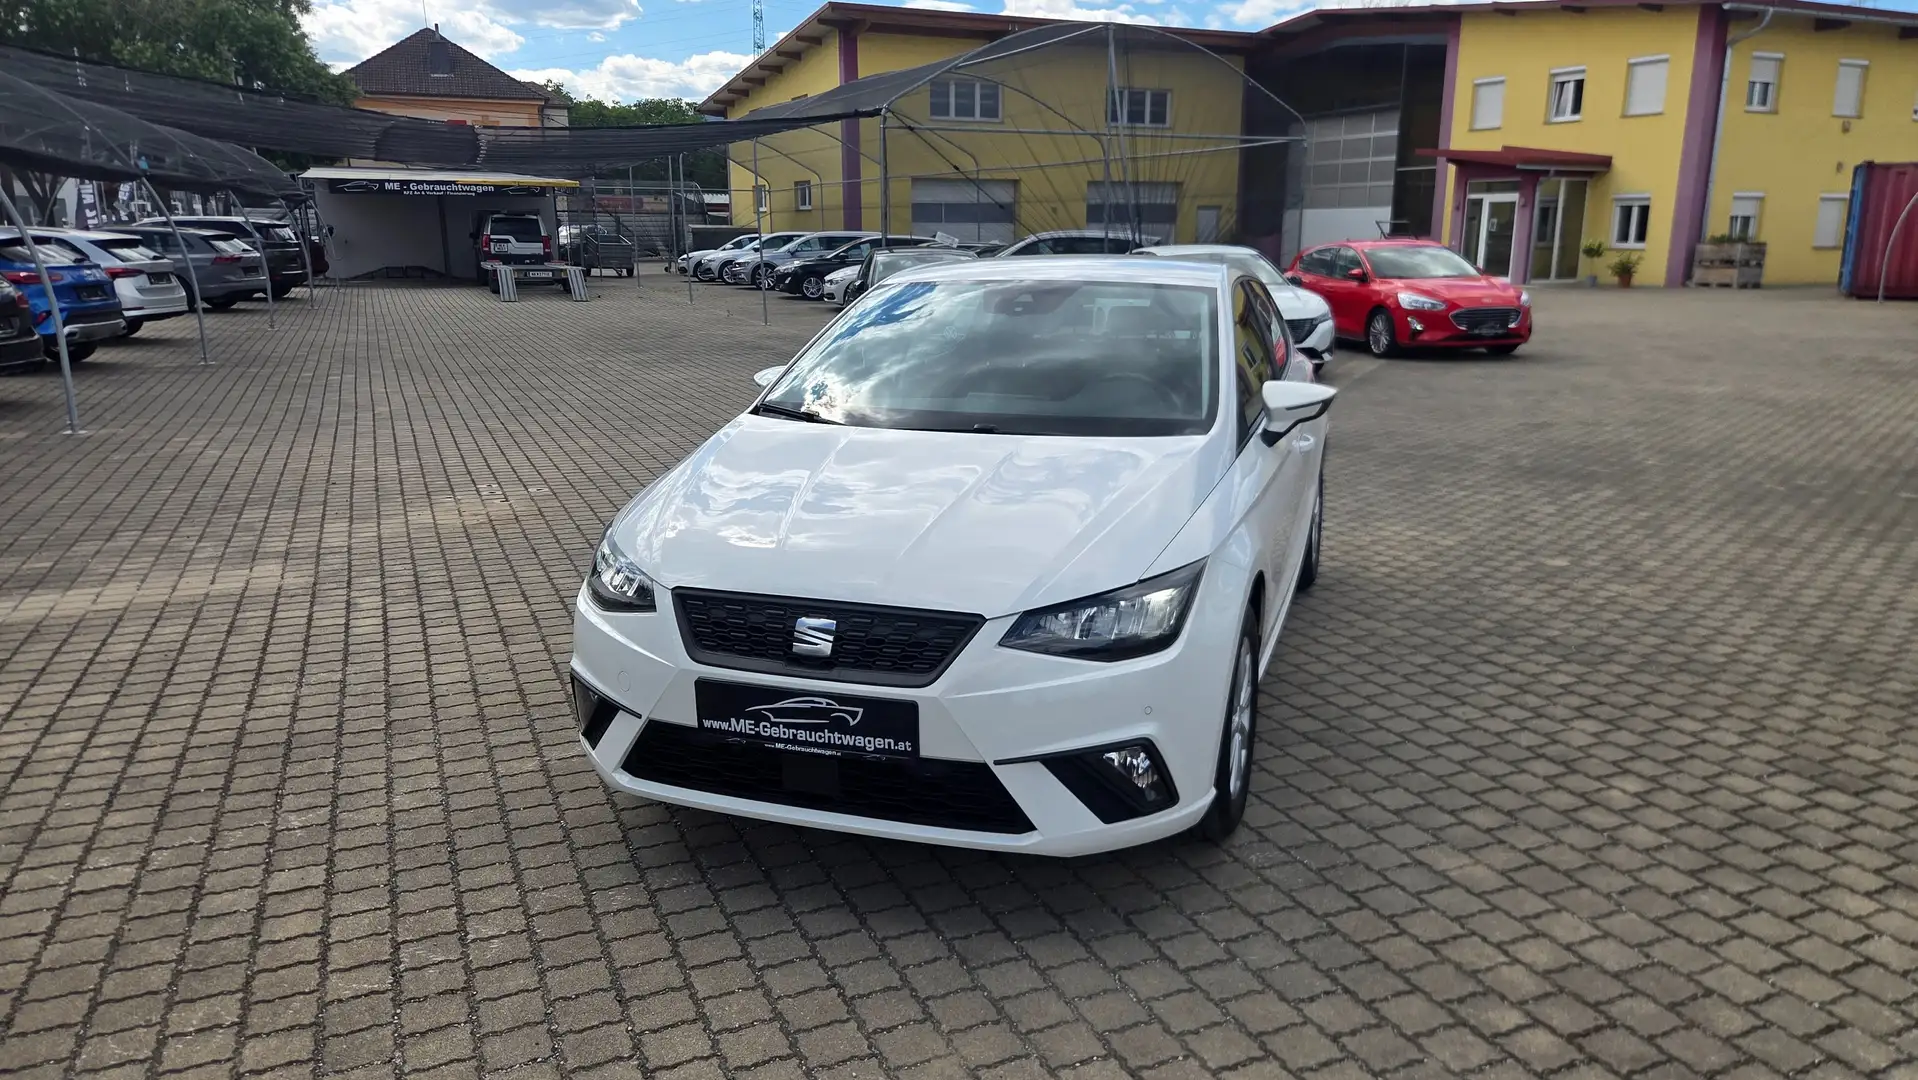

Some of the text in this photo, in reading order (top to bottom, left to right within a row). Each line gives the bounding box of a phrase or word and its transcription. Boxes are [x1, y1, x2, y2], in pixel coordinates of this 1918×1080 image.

[384, 182, 400, 190] ME
[409, 182, 495, 193] Gebrauchtwagen
[702, 717, 912, 751] www.ME-Gebrauchtwagen.at
